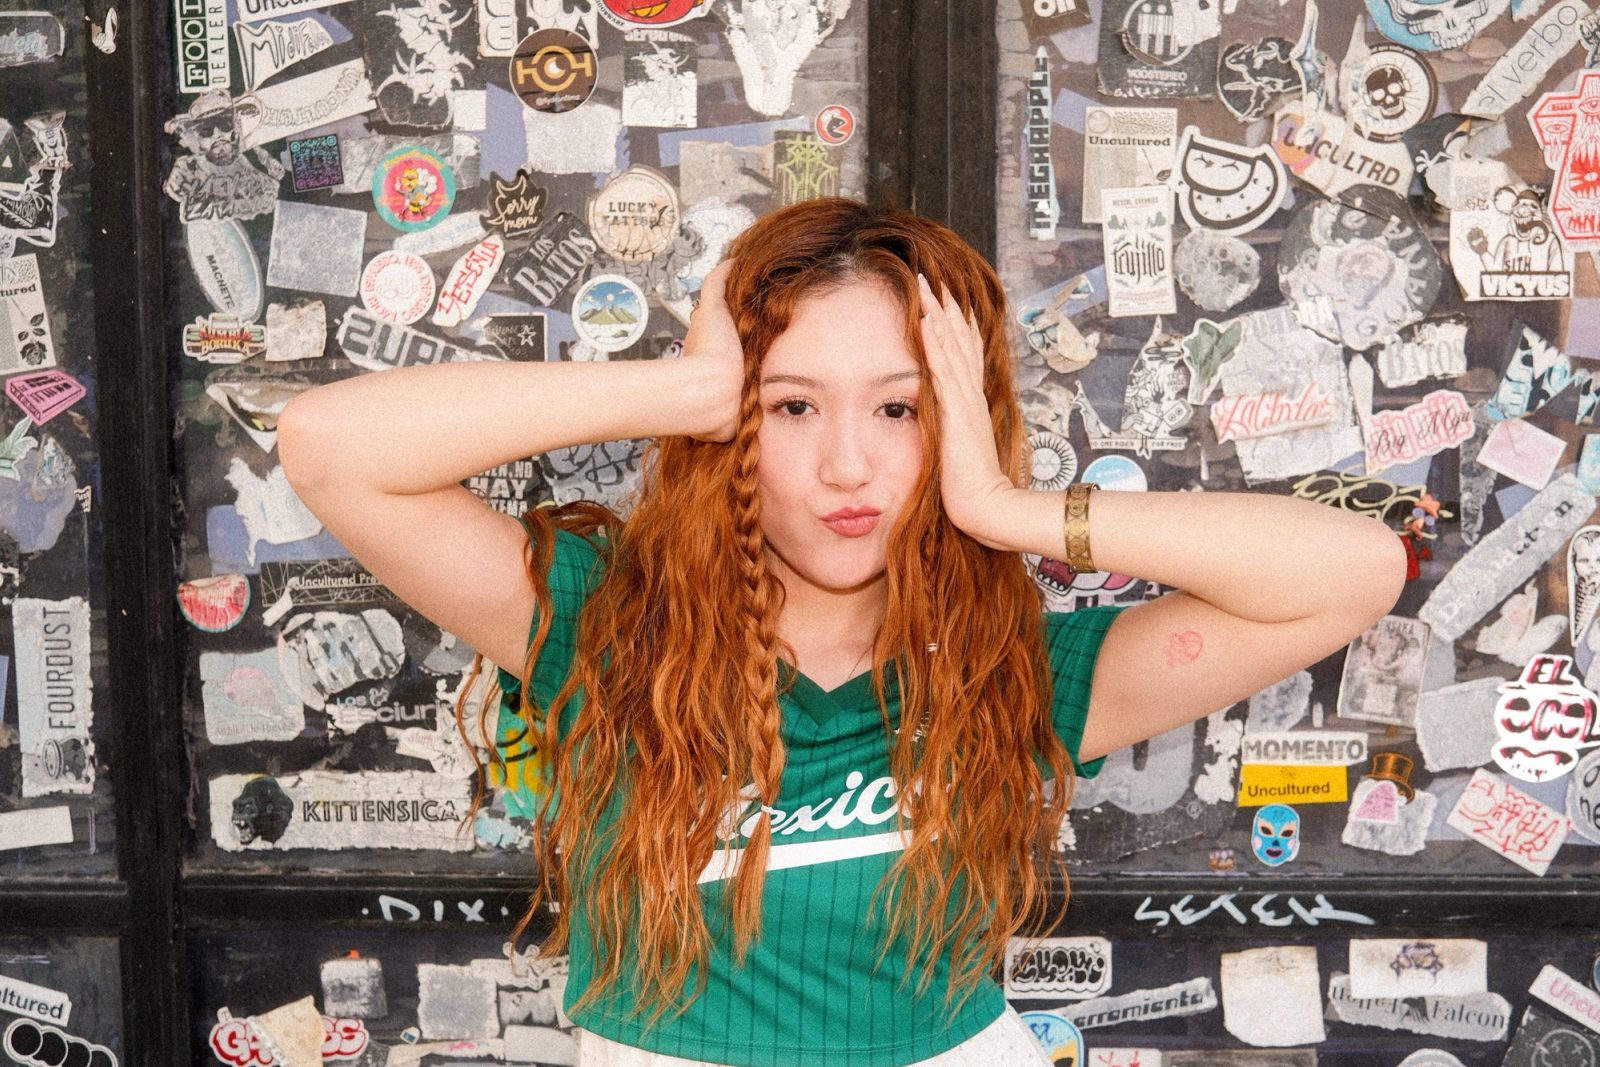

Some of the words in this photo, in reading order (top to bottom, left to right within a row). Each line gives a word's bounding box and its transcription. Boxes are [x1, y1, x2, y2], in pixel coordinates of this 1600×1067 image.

[212, 5, 227, 84] DEALER
[1501, 5, 1578, 86] verbo
[1088, 136, 1171, 147] Uncultured
[487, 193, 541, 226] Sorry
[608, 201, 658, 213] LUCKY
[504, 212, 539, 233] mom
[531, 235, 555, 261] LOS
[512, 227, 599, 307] BATOS
[1505, 256, 1532, 272] SITH
[206, 254, 237, 310] MACHETE
[1480, 273, 1571, 297] VICYUS
[469, 477, 528, 500] HAY
[296, 573, 357, 587] Uncultured
[43, 606, 76, 730] FOURDUST
[1244, 739, 1364, 761] MOMENTO
[1248, 782, 1331, 798] Uncultured
[1432, 999, 1505, 1030] Falcon
